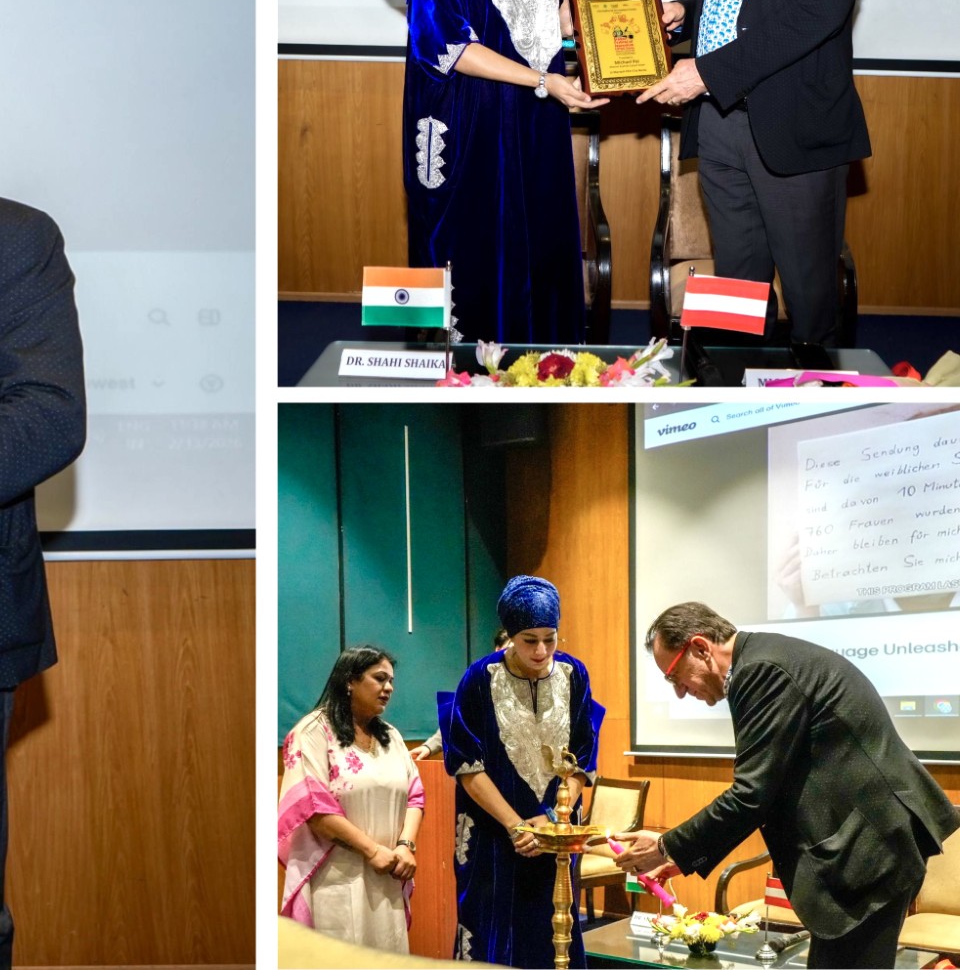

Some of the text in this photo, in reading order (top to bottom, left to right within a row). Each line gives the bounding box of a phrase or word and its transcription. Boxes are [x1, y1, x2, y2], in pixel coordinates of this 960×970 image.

[346, 355, 365, 367] DR.
[367, 356, 402, 368] SHAHI
[88, 376, 136, 390] west
[726, 404, 775, 420] Search all of
[657, 421, 697, 437] vimeo
[805, 457, 841, 471] Diese
[860, 443, 920, 461] Sendung
[843, 473, 860, 485] die
[874, 461, 941, 479] weiblichen
[897, 485, 917, 497] 10
[804, 524, 834, 537] 760
[848, 517, 894, 531] Frauen
[853, 535, 899, 550] bleiben
[910, 529, 930, 545] für
[903, 553, 925, 569] Sie
[856, 587, 881, 597] THIS
[882, 581, 936, 595] PROGRAM
